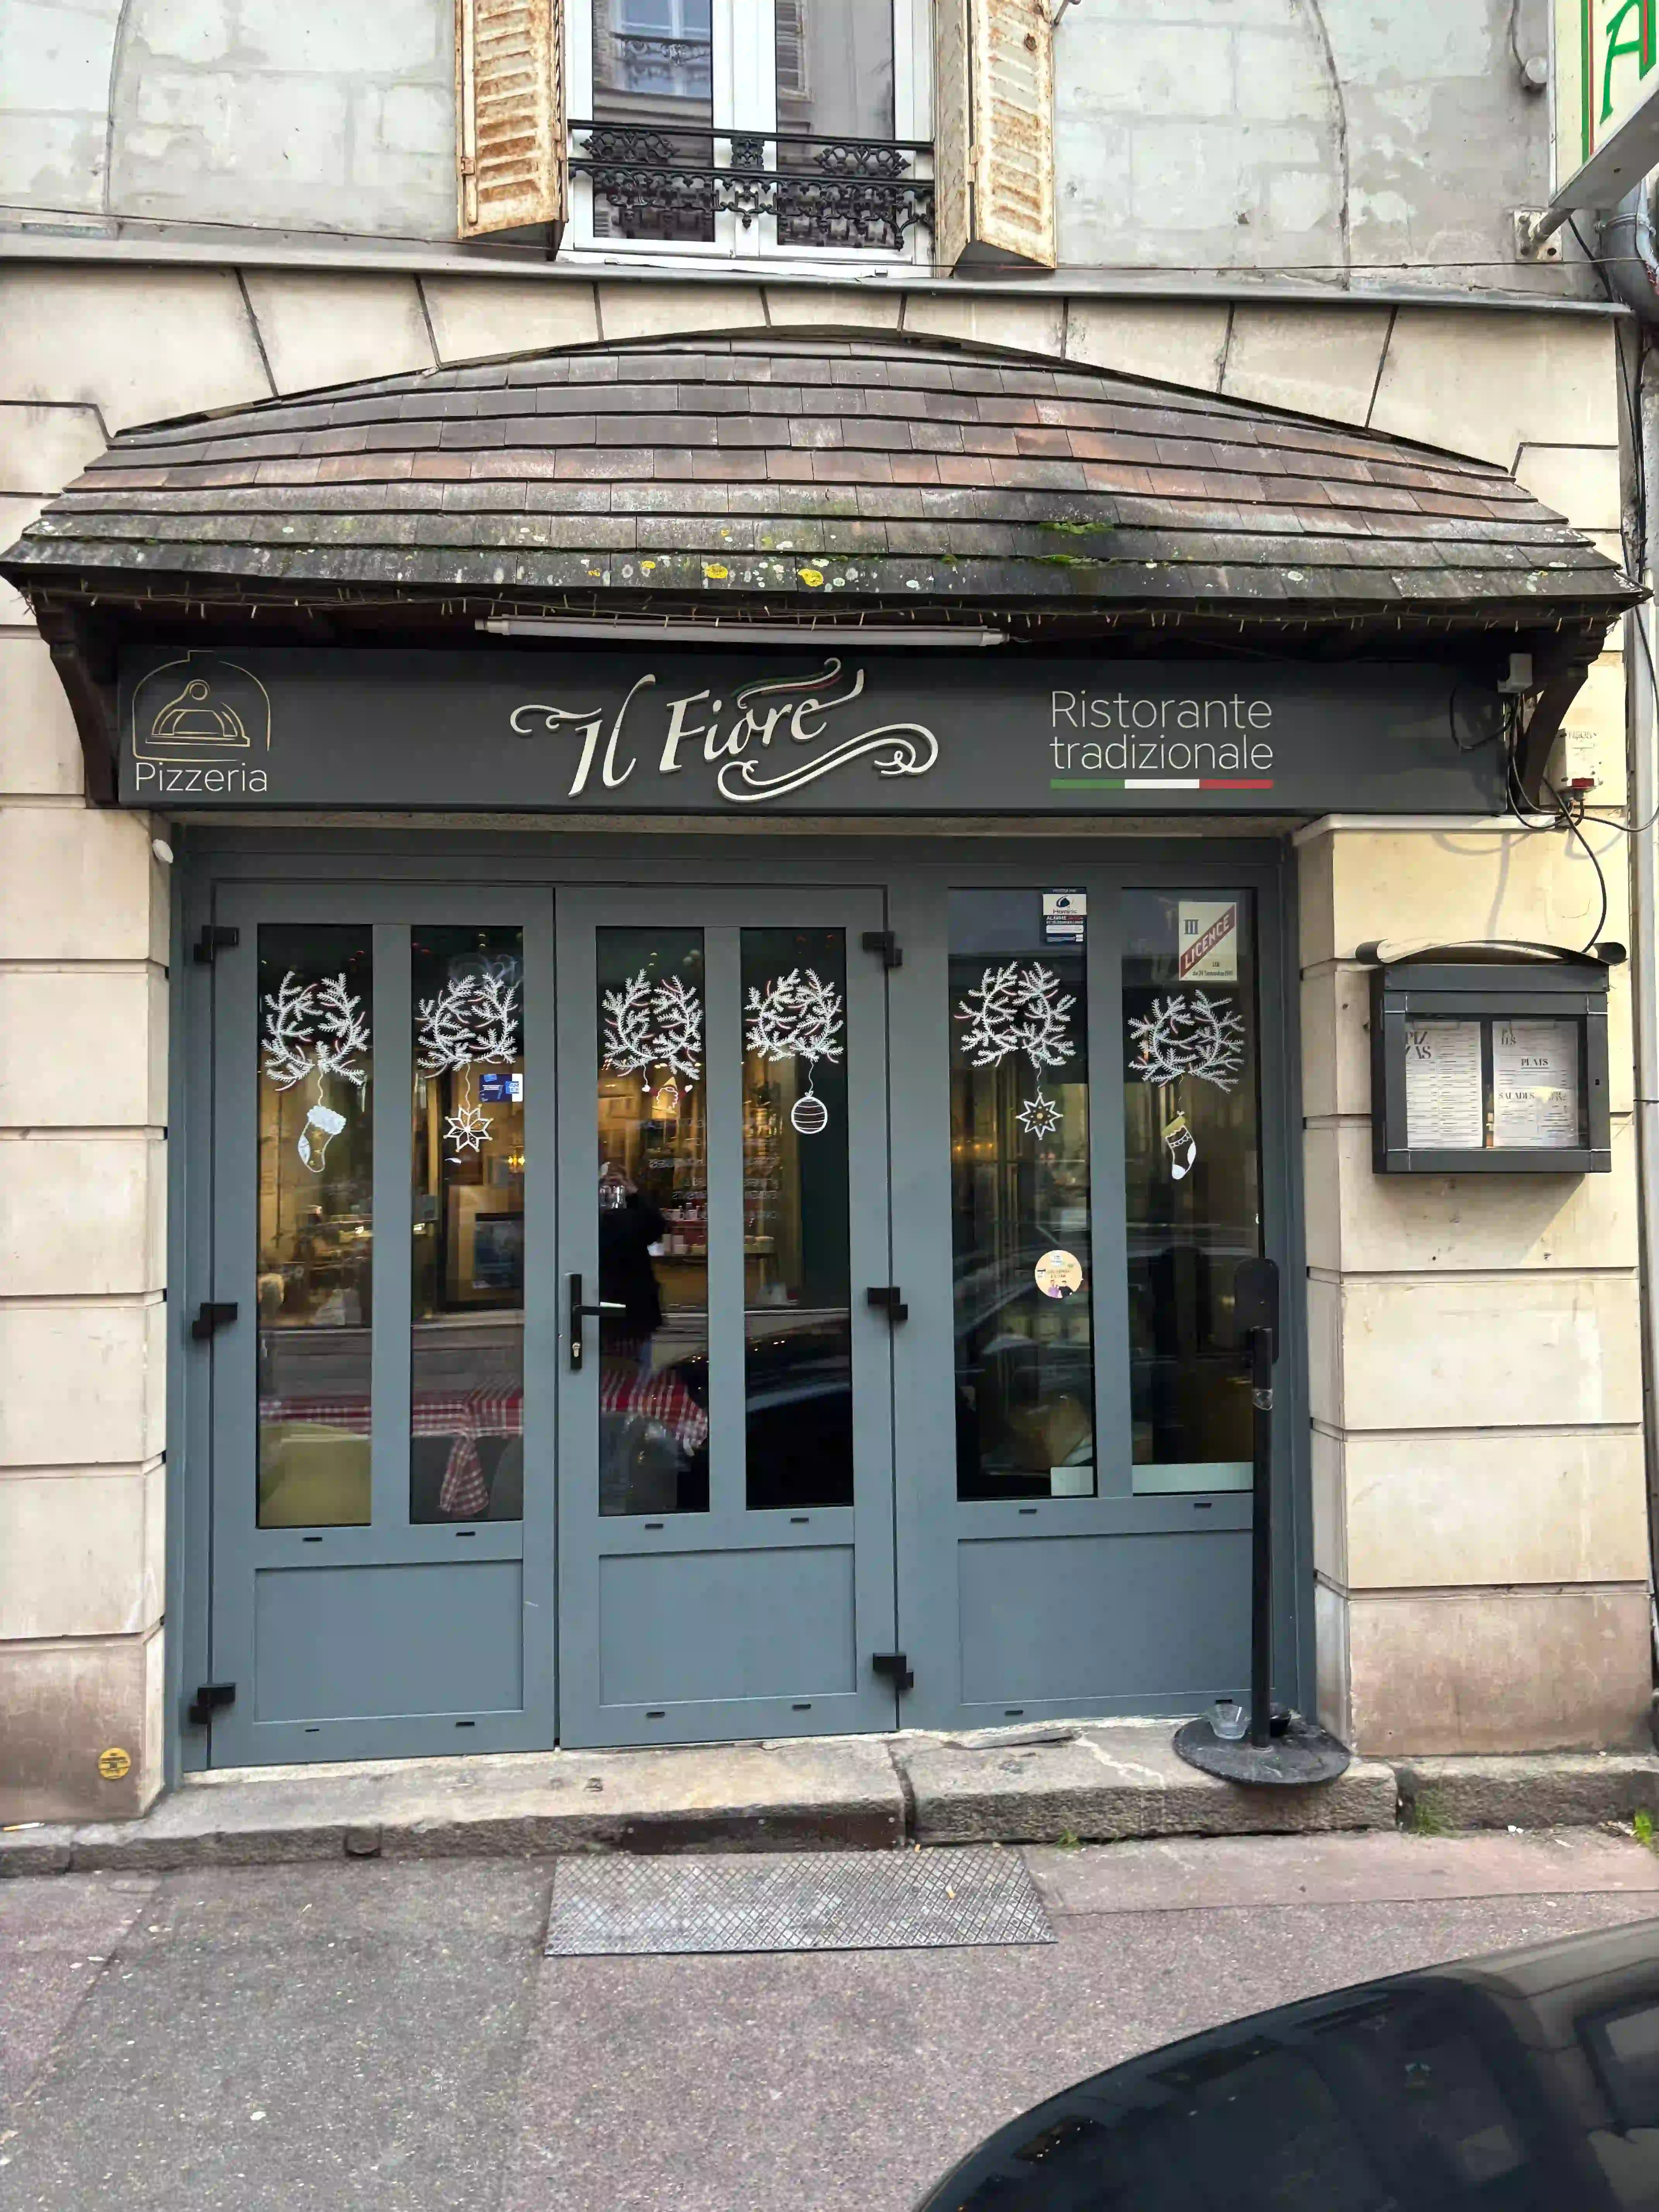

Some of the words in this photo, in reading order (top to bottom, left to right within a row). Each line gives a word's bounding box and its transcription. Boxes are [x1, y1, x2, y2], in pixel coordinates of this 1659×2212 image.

[1052, 690, 1272, 728] Ristorante
[510, 674, 656, 797] Il
[659, 668, 864, 774] Fiore
[1049, 734, 1273, 769] tradizionale
[136, 762, 267, 792] Pizzeria
[1183, 919, 1199, 934] III
[1185, 914, 1230, 969] LICENCE
